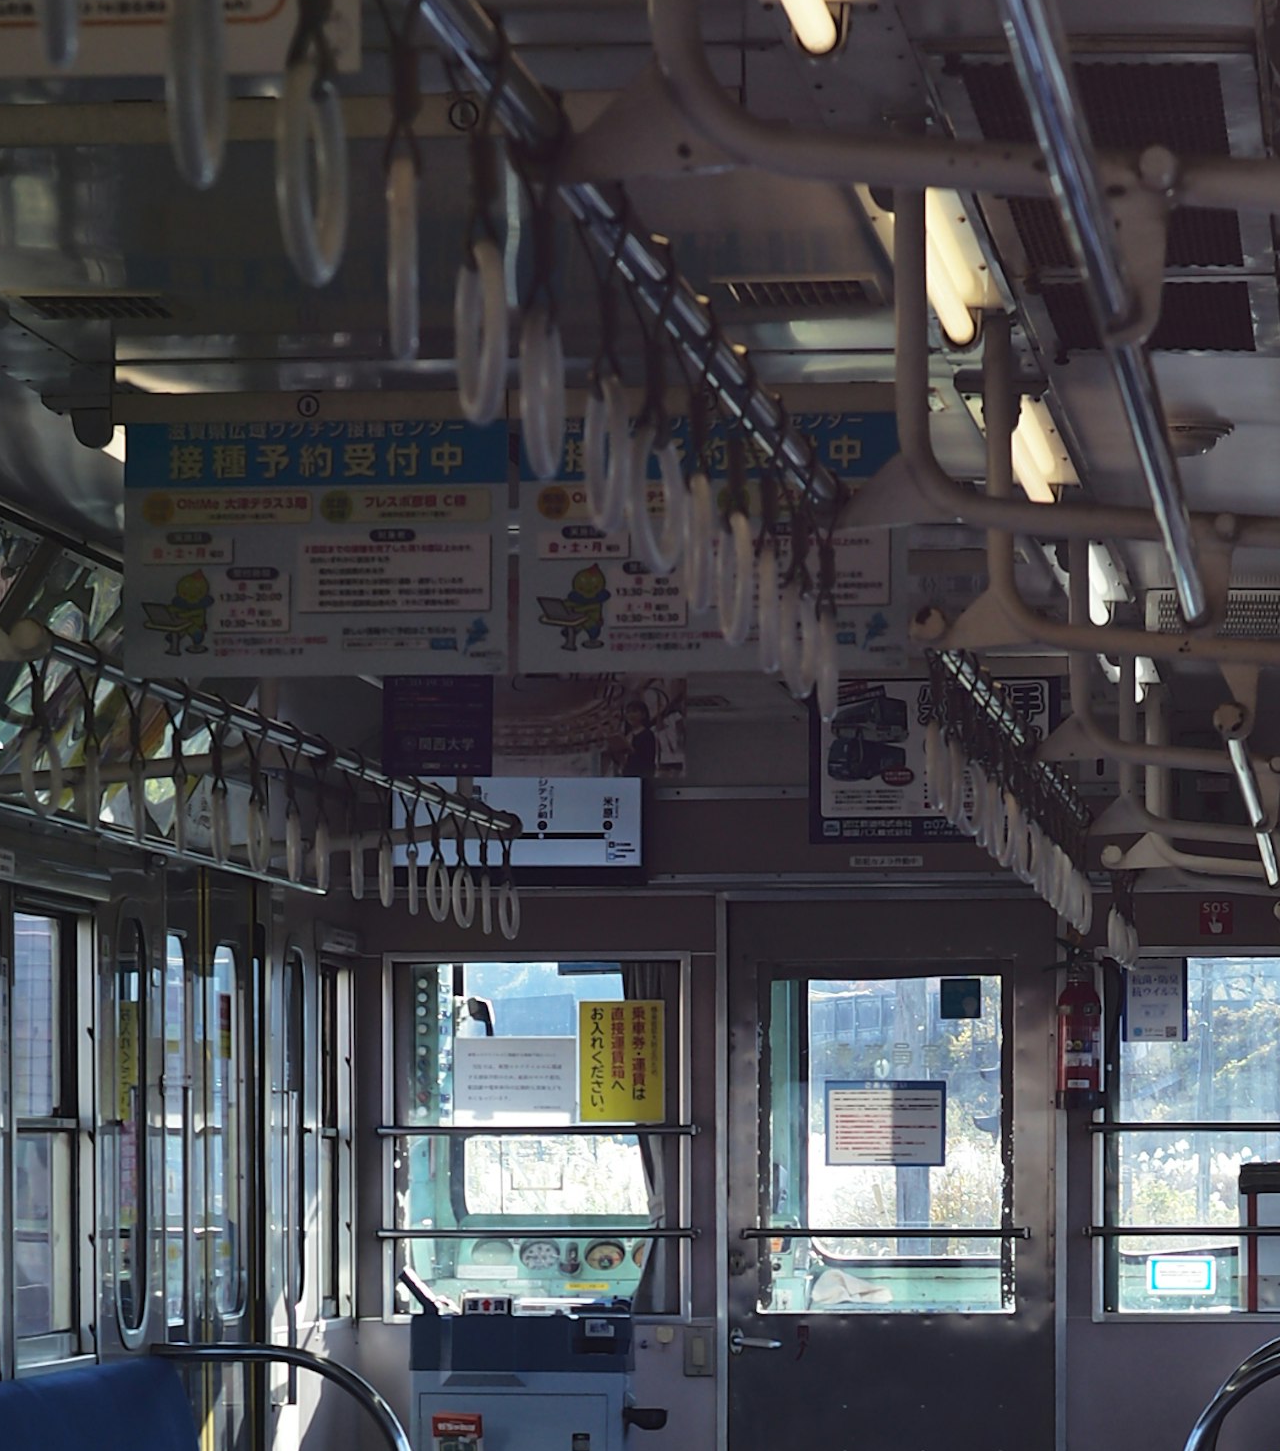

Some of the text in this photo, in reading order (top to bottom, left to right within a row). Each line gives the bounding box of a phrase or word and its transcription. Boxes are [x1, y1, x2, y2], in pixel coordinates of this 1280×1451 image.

[169, 443, 464, 480] 接種予約受付中
[418, 736, 475, 752] 関西大学
[603, 796, 614, 819] 米原
[1202, 902, 1230, 914] SOS
[1131, 986, 1179, 998] 抗ウイルス
[590, 1007, 605, 1112] お入れください。
[610, 1007, 625, 1091] 直接運賃箱へ
[632, 1006, 646, 1100] 乗車券・運賃は
